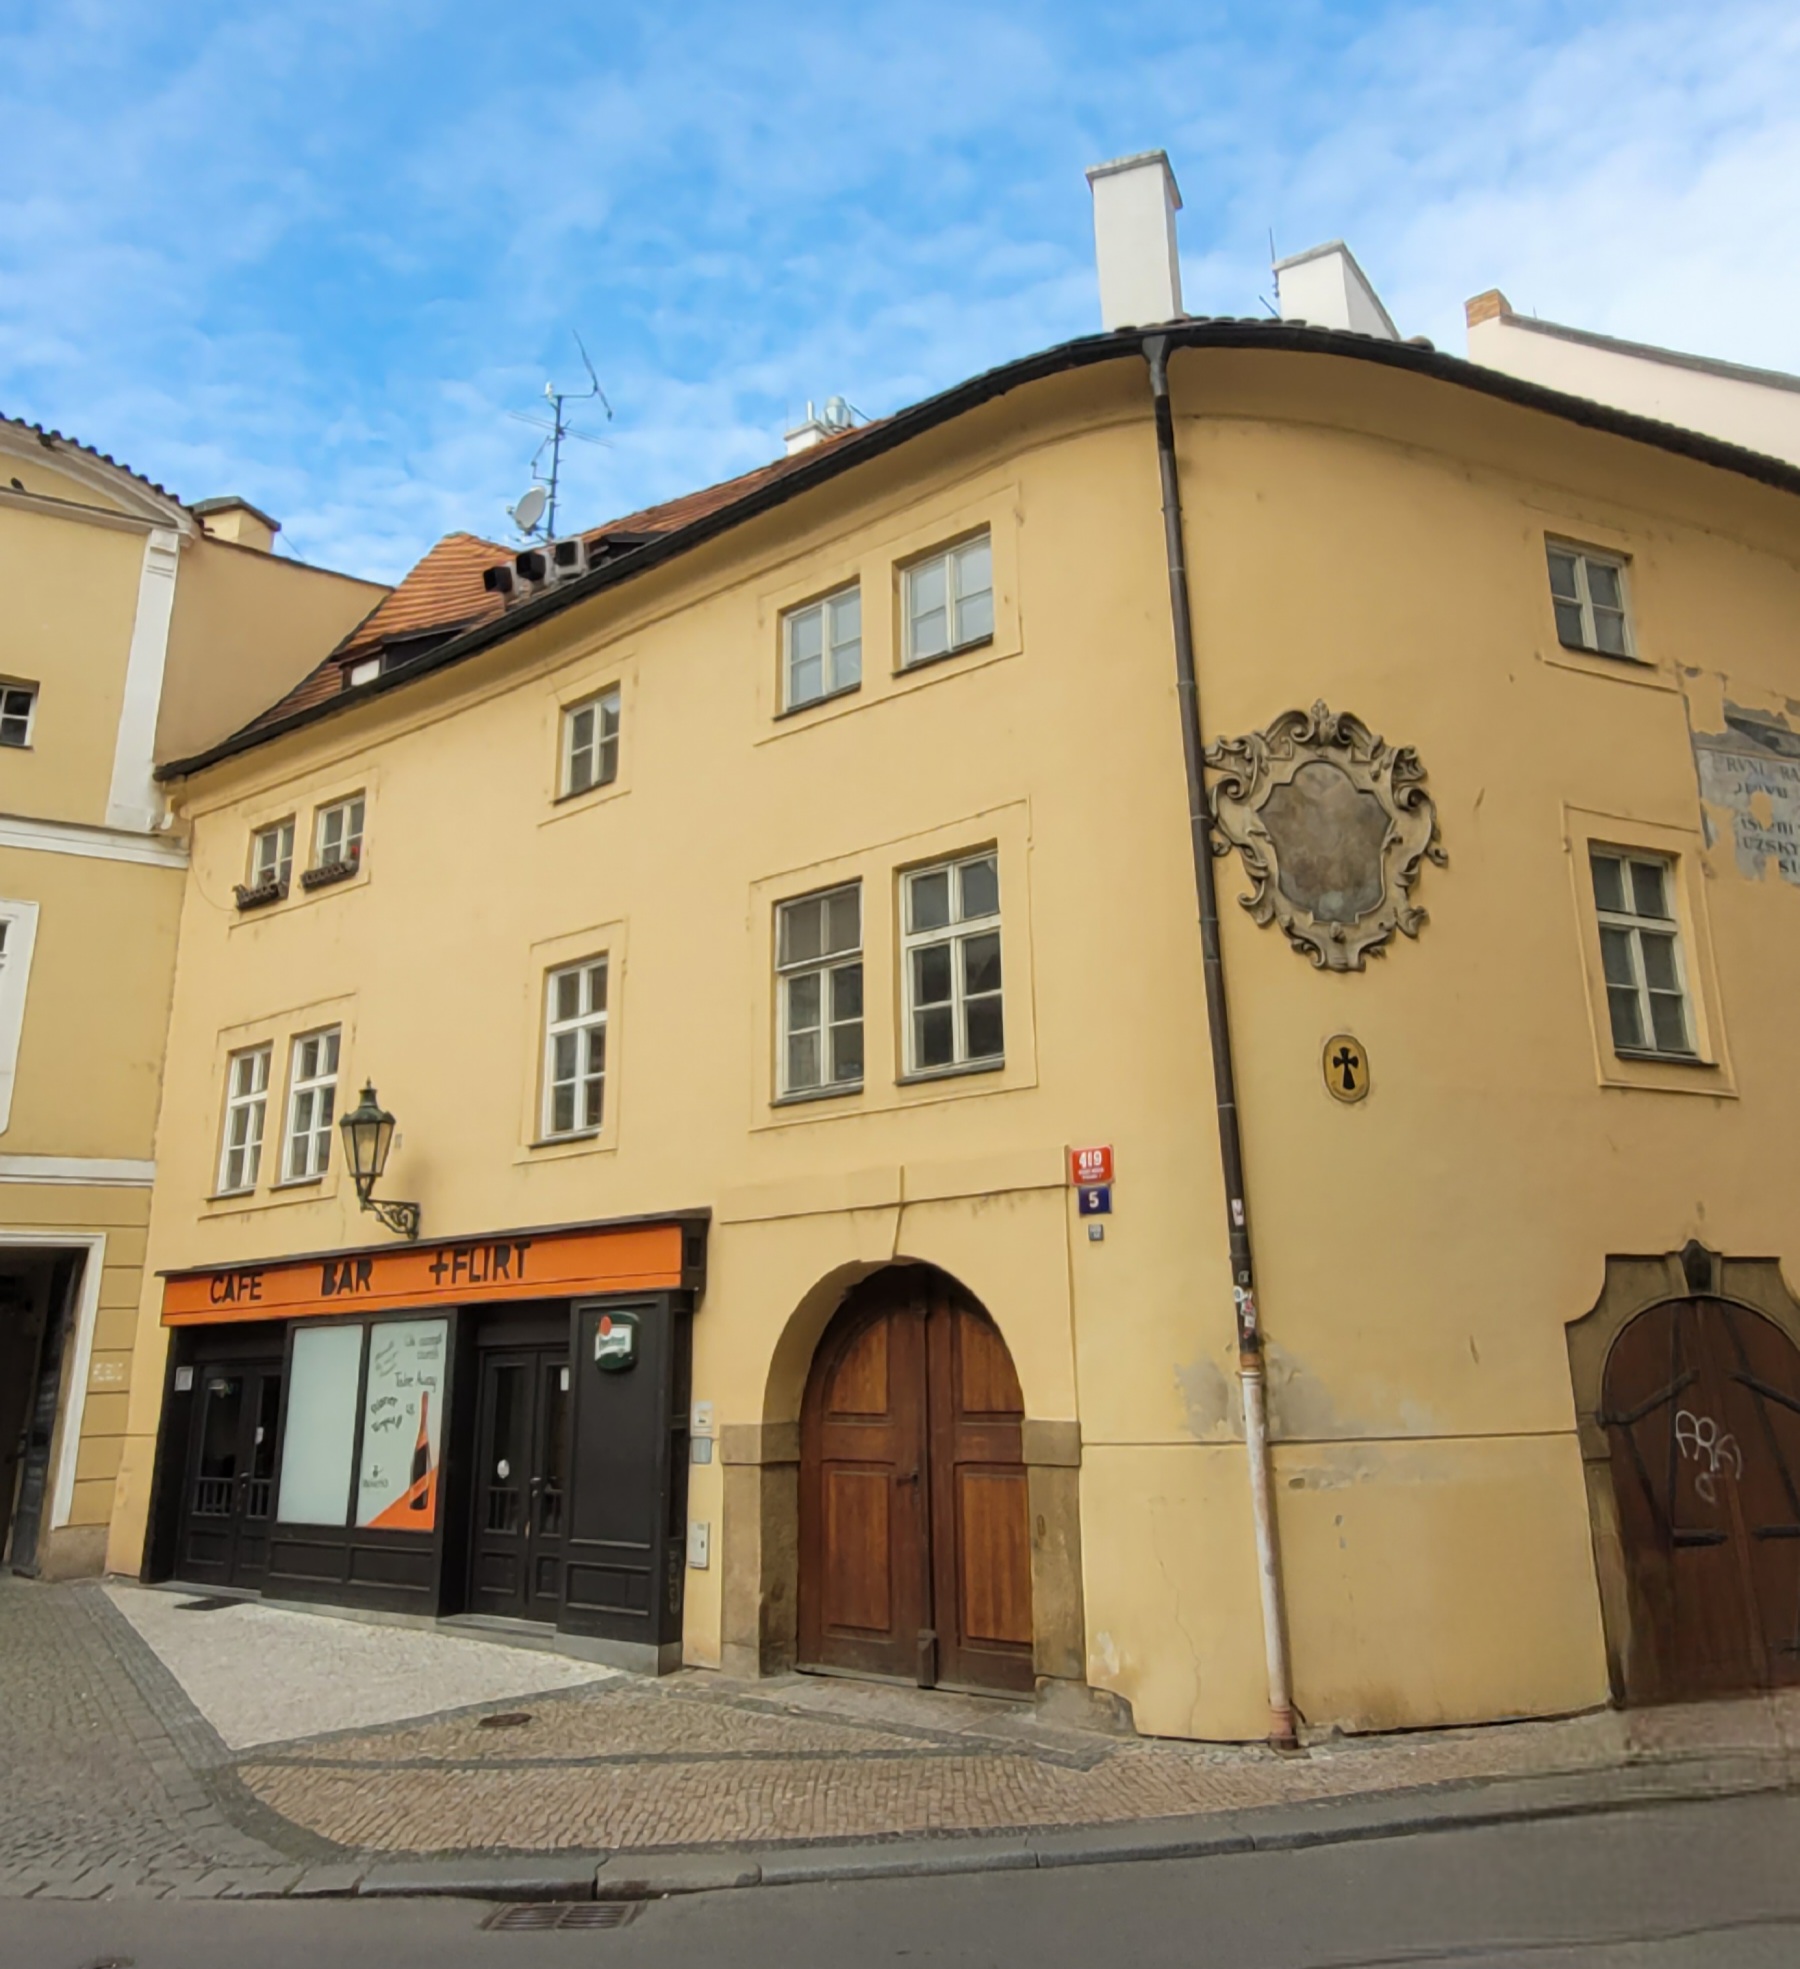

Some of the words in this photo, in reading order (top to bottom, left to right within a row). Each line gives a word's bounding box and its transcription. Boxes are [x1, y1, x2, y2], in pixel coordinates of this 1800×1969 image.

[1079, 1150, 1103, 1169] 419
[1088, 1191, 1100, 1209] 5
[210, 1272, 264, 1305] CAFE
[321, 1258, 373, 1297] BAR
